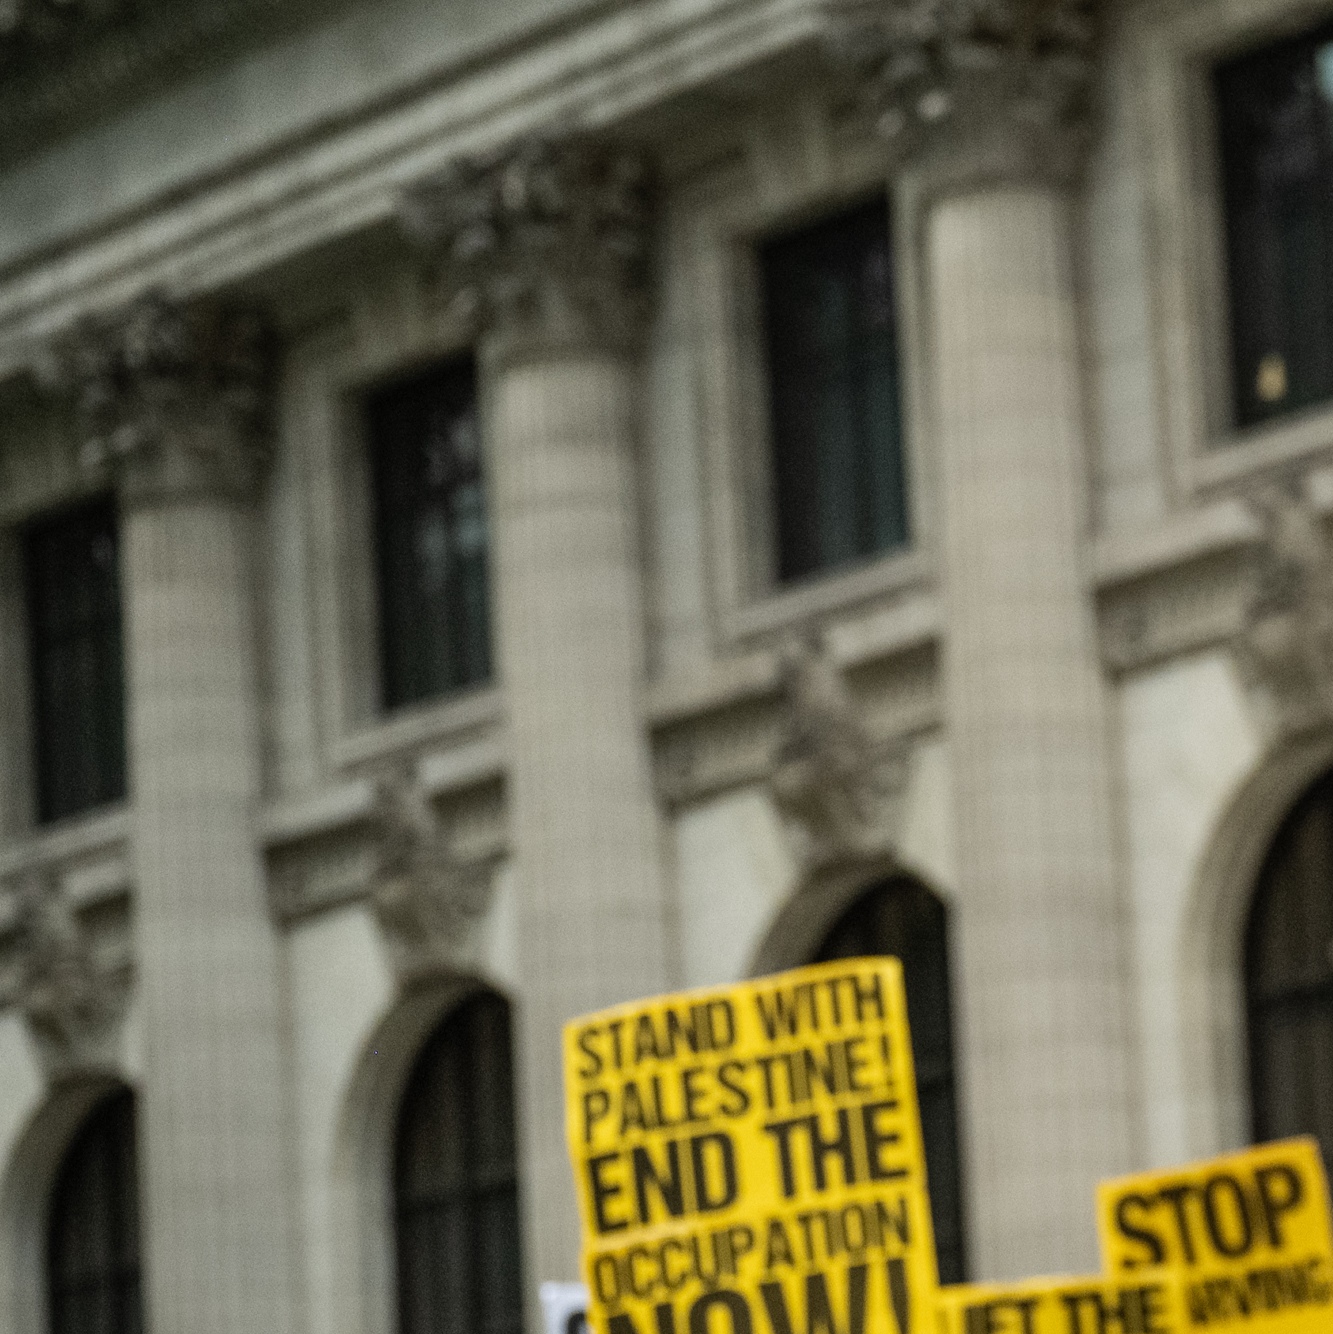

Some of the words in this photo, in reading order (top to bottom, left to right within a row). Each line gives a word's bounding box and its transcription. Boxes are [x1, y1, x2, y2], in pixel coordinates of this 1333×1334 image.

[577, 998, 738, 1079] STAND
[755, 971, 886, 1042] WITH
[583, 1032, 895, 1147] PALESTINE!
[585, 1130, 740, 1235] END
[764, 1098, 908, 1198] THE
[1114, 1161, 1306, 1269] STOP
[592, 1198, 914, 1303] OCCUPATION
